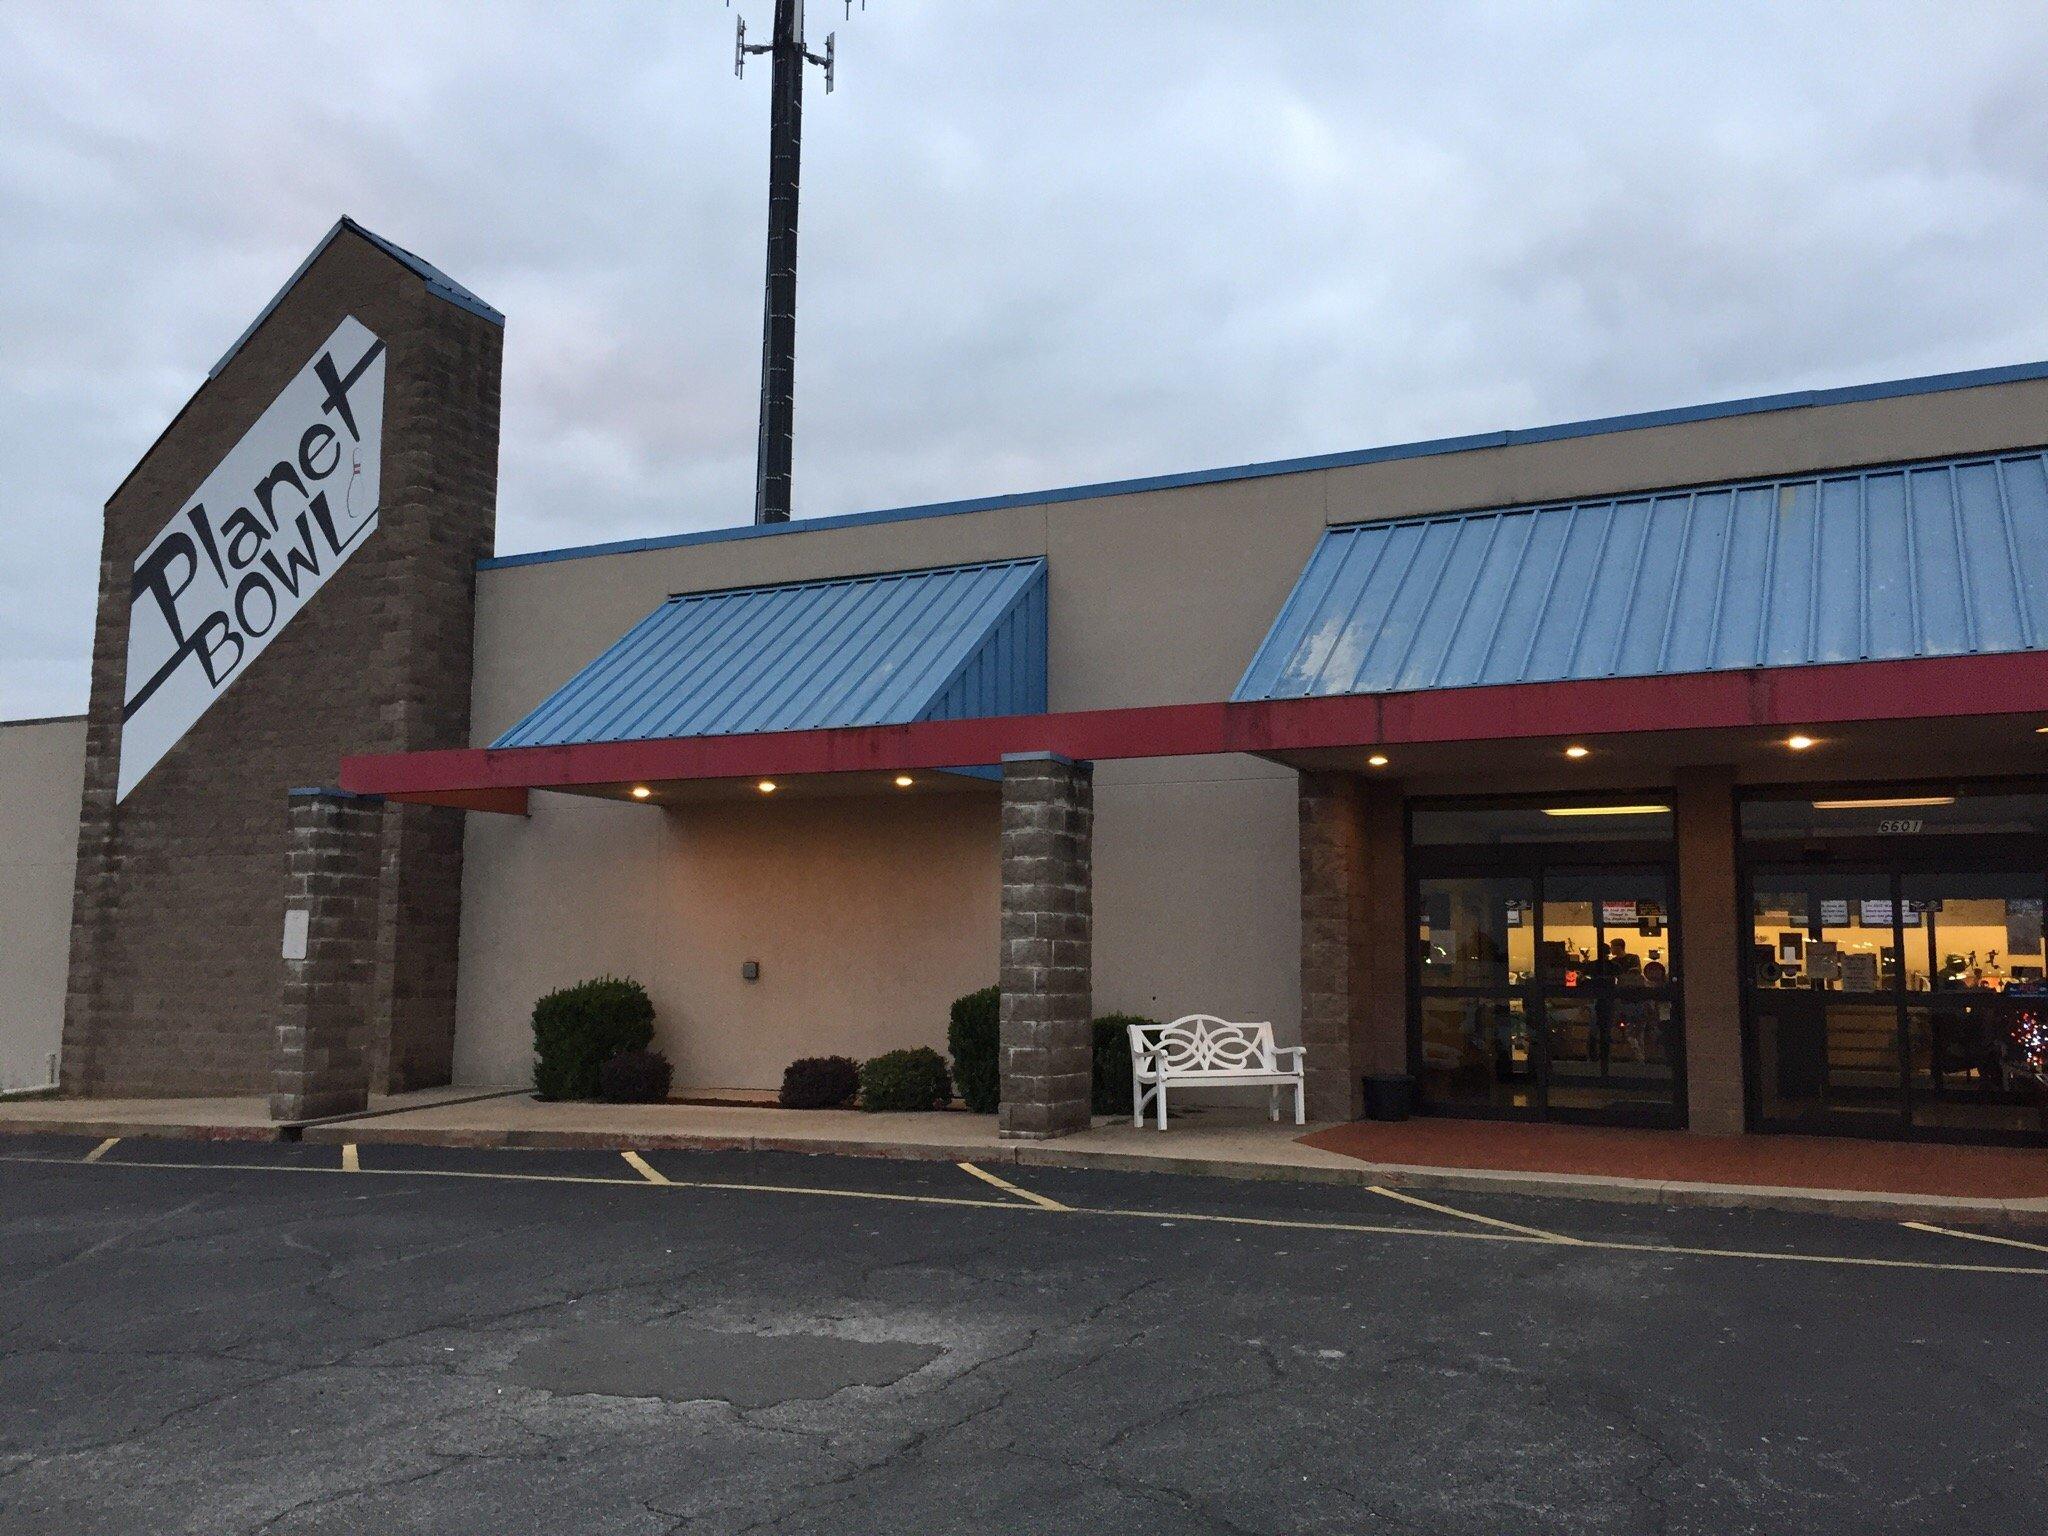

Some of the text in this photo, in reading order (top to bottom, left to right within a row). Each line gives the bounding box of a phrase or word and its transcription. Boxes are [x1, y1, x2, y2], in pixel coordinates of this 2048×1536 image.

[132, 340, 385, 650] Planet
[194, 490, 378, 690] BOWL
[1880, 820, 1919, 832] 6601
